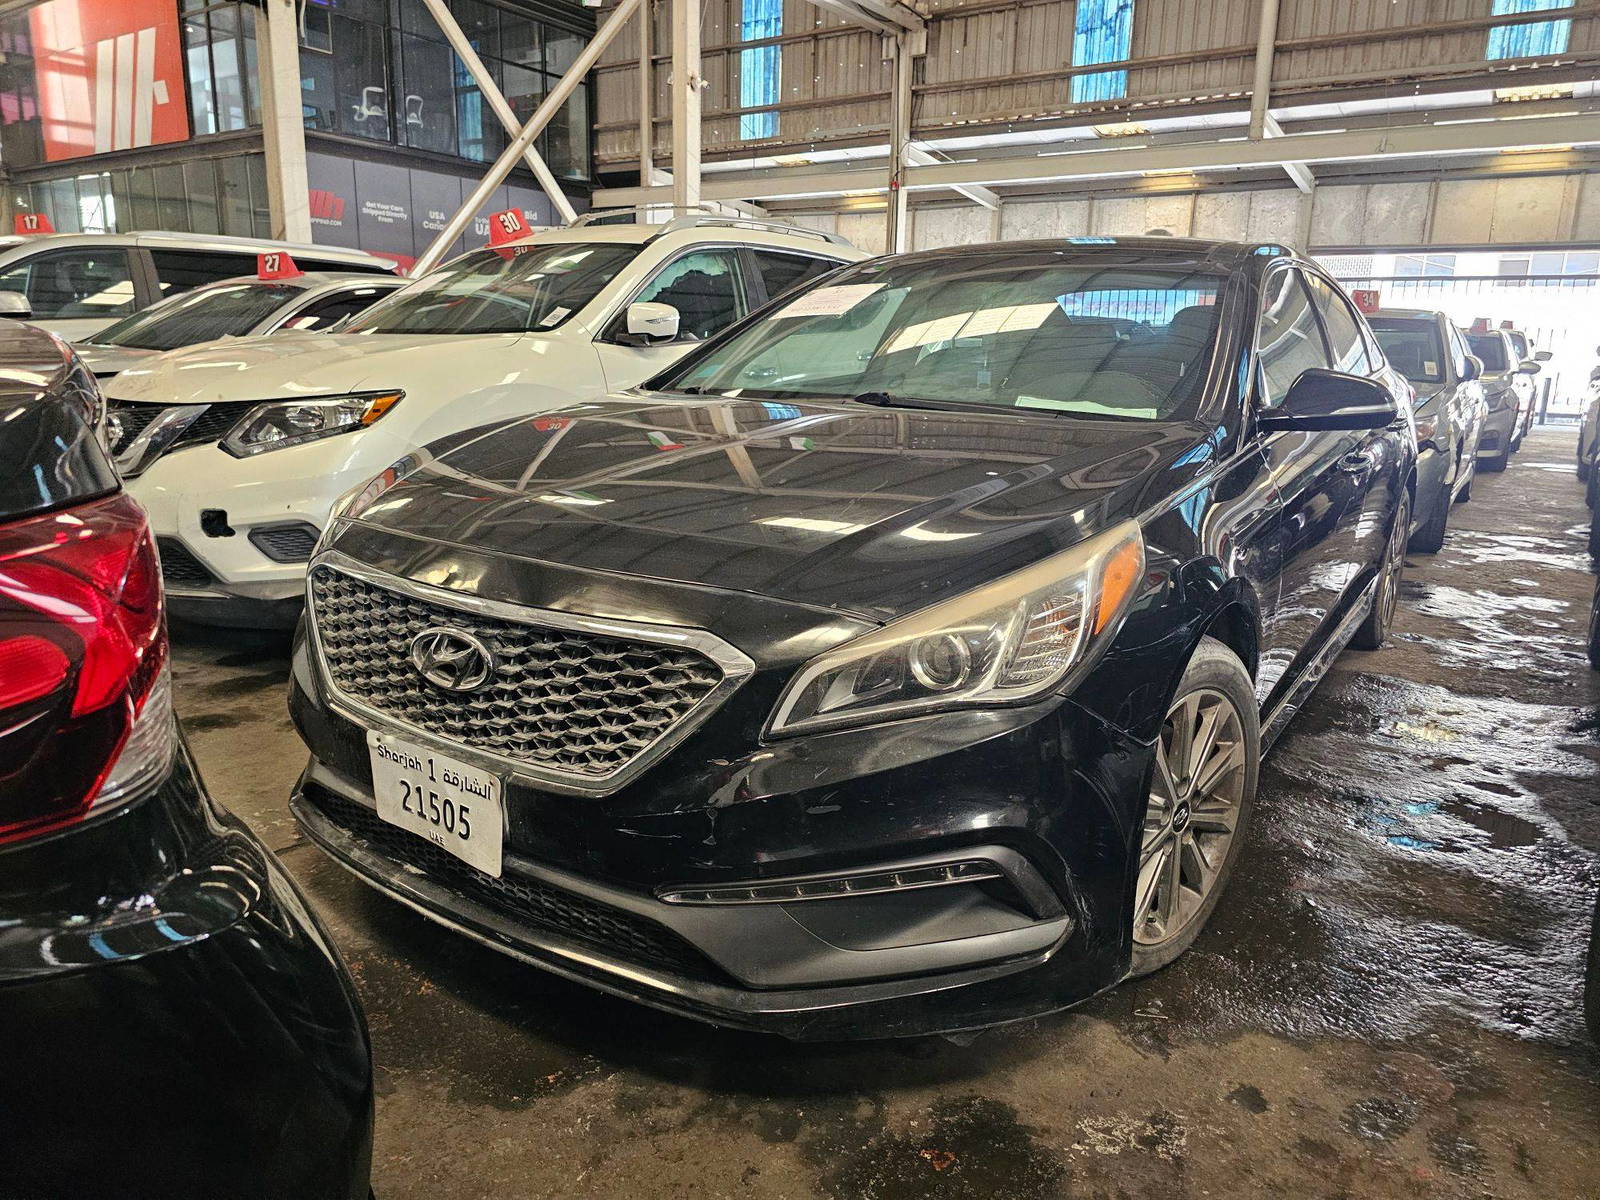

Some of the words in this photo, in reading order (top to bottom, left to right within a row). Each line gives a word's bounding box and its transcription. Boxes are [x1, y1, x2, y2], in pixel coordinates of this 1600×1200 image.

[362, 207, 385, 217] Shipped
[377, 202, 390, 210] Your
[24, 215, 38, 229] 17
[429, 210, 445, 220] USA
[499, 211, 521, 234] 30
[423, 220, 444, 230] Cana
[475, 223, 490, 235] UA
[265, 254, 280, 272] 27
[377, 744, 423, 773] Sharjah
[428, 758, 437, 783] 1
[443, 768, 492, 800] الشارقة
[400, 779, 471, 841] 21505
[430, 830, 445, 846] UAE
